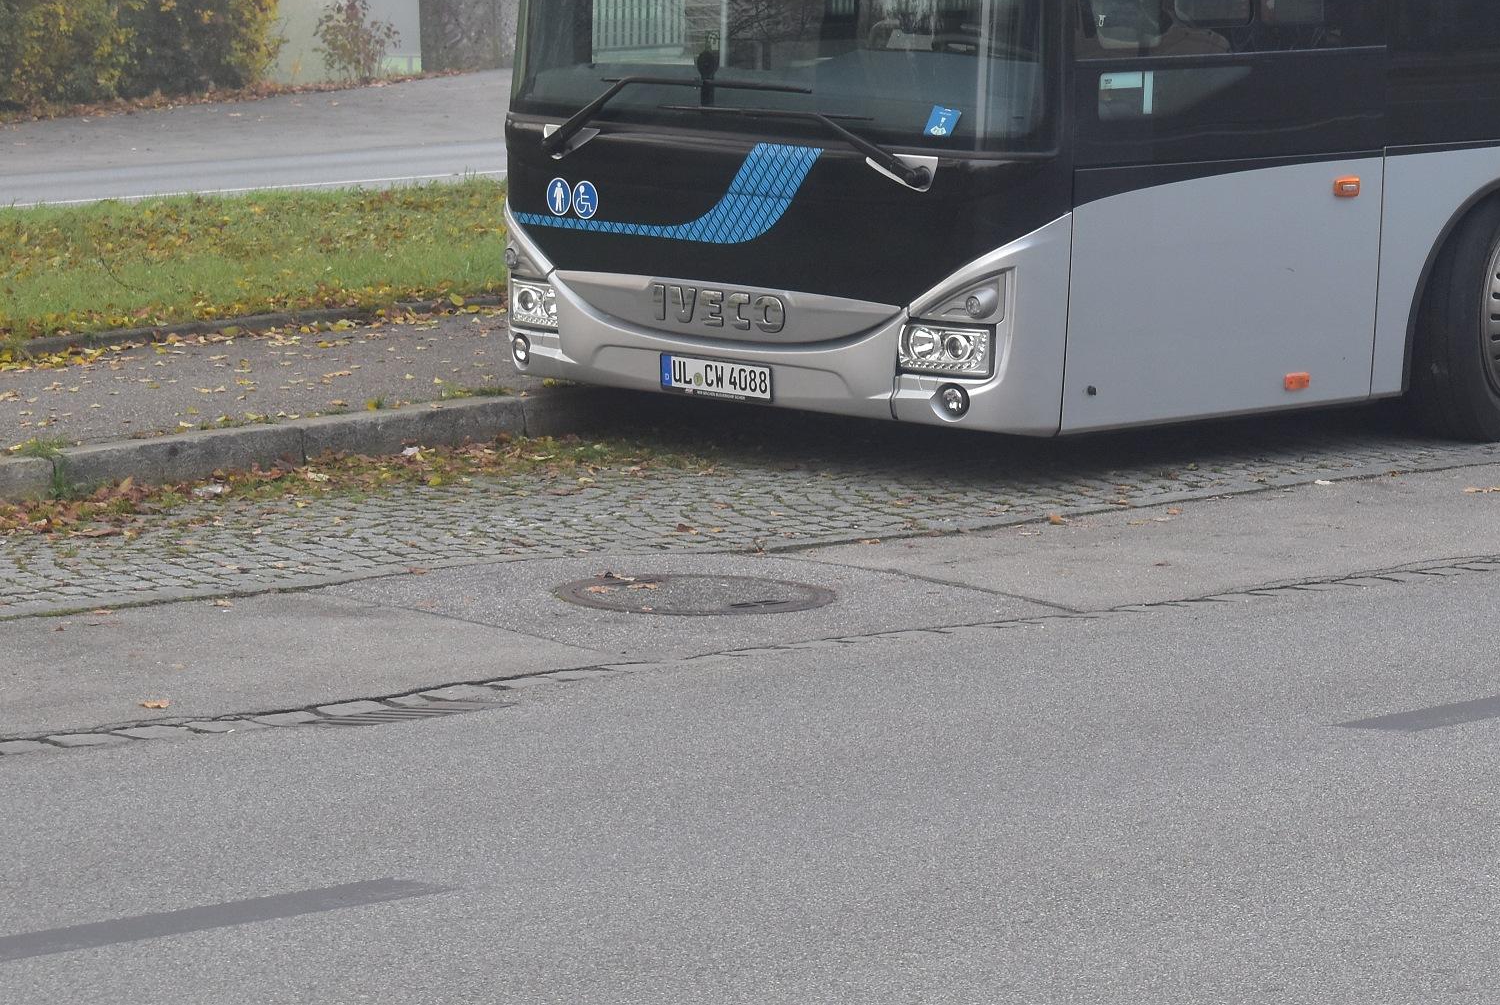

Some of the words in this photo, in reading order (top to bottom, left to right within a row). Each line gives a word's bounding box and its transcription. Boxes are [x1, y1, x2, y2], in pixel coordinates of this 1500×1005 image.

[652, 283, 786, 334] IVECO
[664, 373, 670, 381] D
[672, 360, 692, 385] UL
[704, 363, 724, 389] CW
[729, 366, 768, 394] 4088
